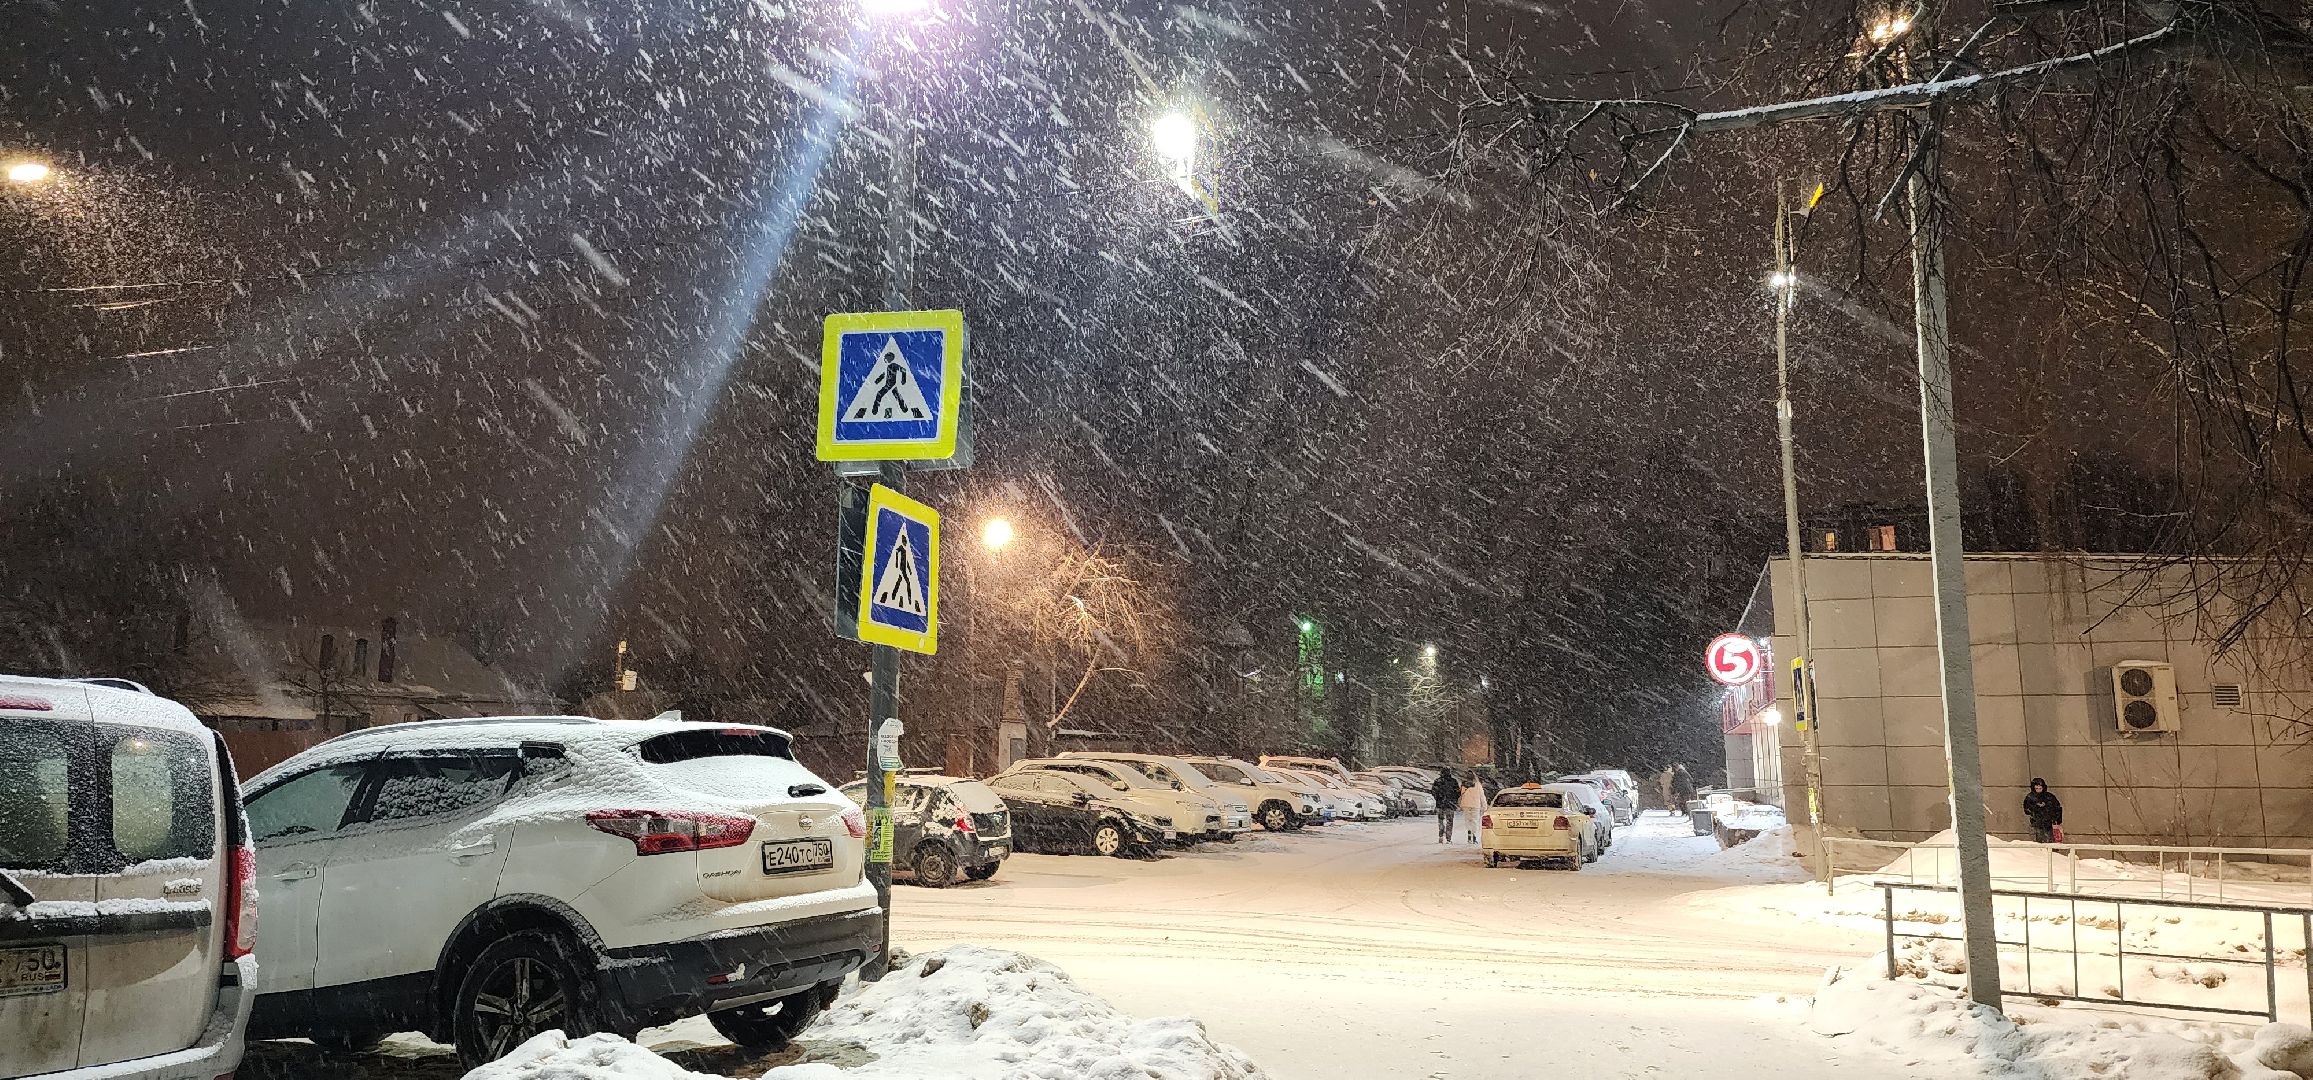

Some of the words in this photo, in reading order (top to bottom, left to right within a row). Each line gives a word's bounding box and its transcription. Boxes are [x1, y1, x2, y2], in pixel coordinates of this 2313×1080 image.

[1720, 641, 1751, 681] 5
[769, 846, 813, 866] E240TC
[813, 843, 830, 856] 750
[21, 972, 45, 981] RUS
